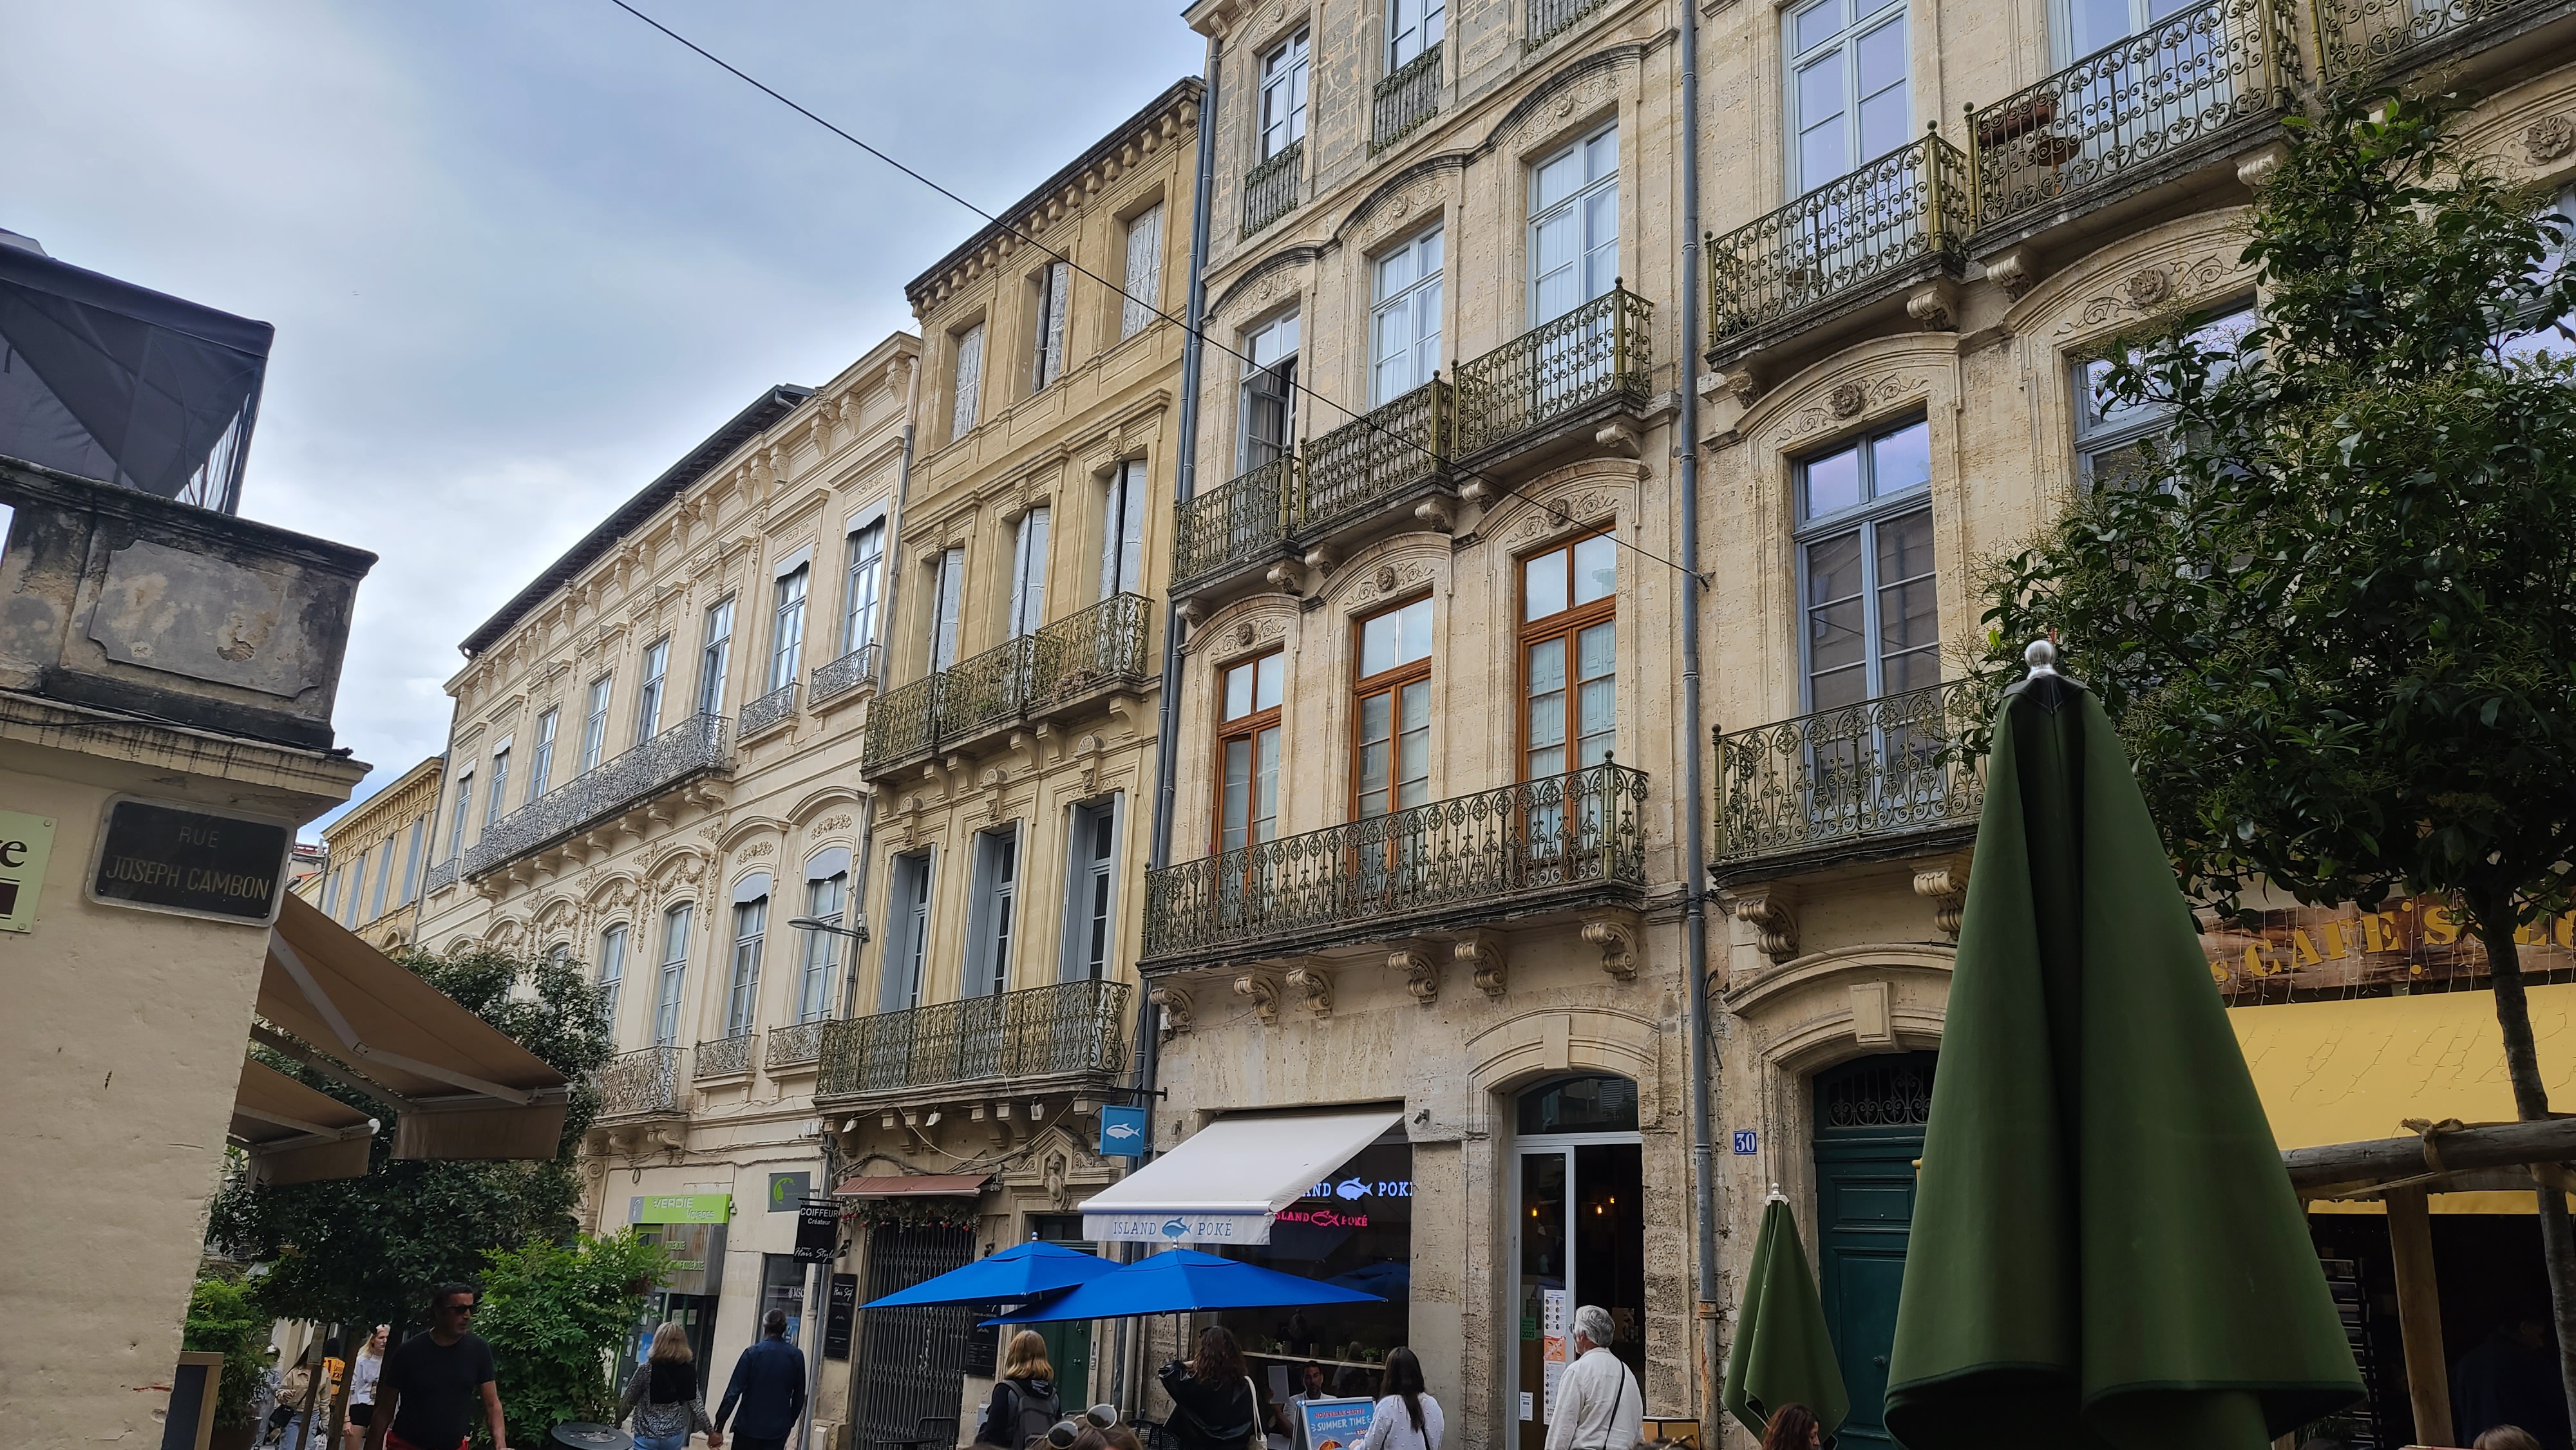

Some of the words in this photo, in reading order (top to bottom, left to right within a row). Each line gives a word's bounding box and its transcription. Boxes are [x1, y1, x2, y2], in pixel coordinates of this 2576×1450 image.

[179, 826, 220, 849] RUE
[0, 839, 28, 868] e
[106, 855, 182, 887] JOSEPH
[187, 868, 270, 901] CAMBON
[1736, 1133, 1756, 1152] 30
[686, 1208, 714, 1220] Voyages
[800, 1207, 838, 1218] COIFFEUR
[1275, 1210, 1310, 1222] SLAND
[1341, 1214, 1368, 1227] POKÉ
[1113, 1221, 1157, 1235] ISLAND
[1197, 1219, 1232, 1236] POKÉ
[1317, 1419, 1347, 1431] SUMMER
[1349, 1417, 1366, 1426] TIME
